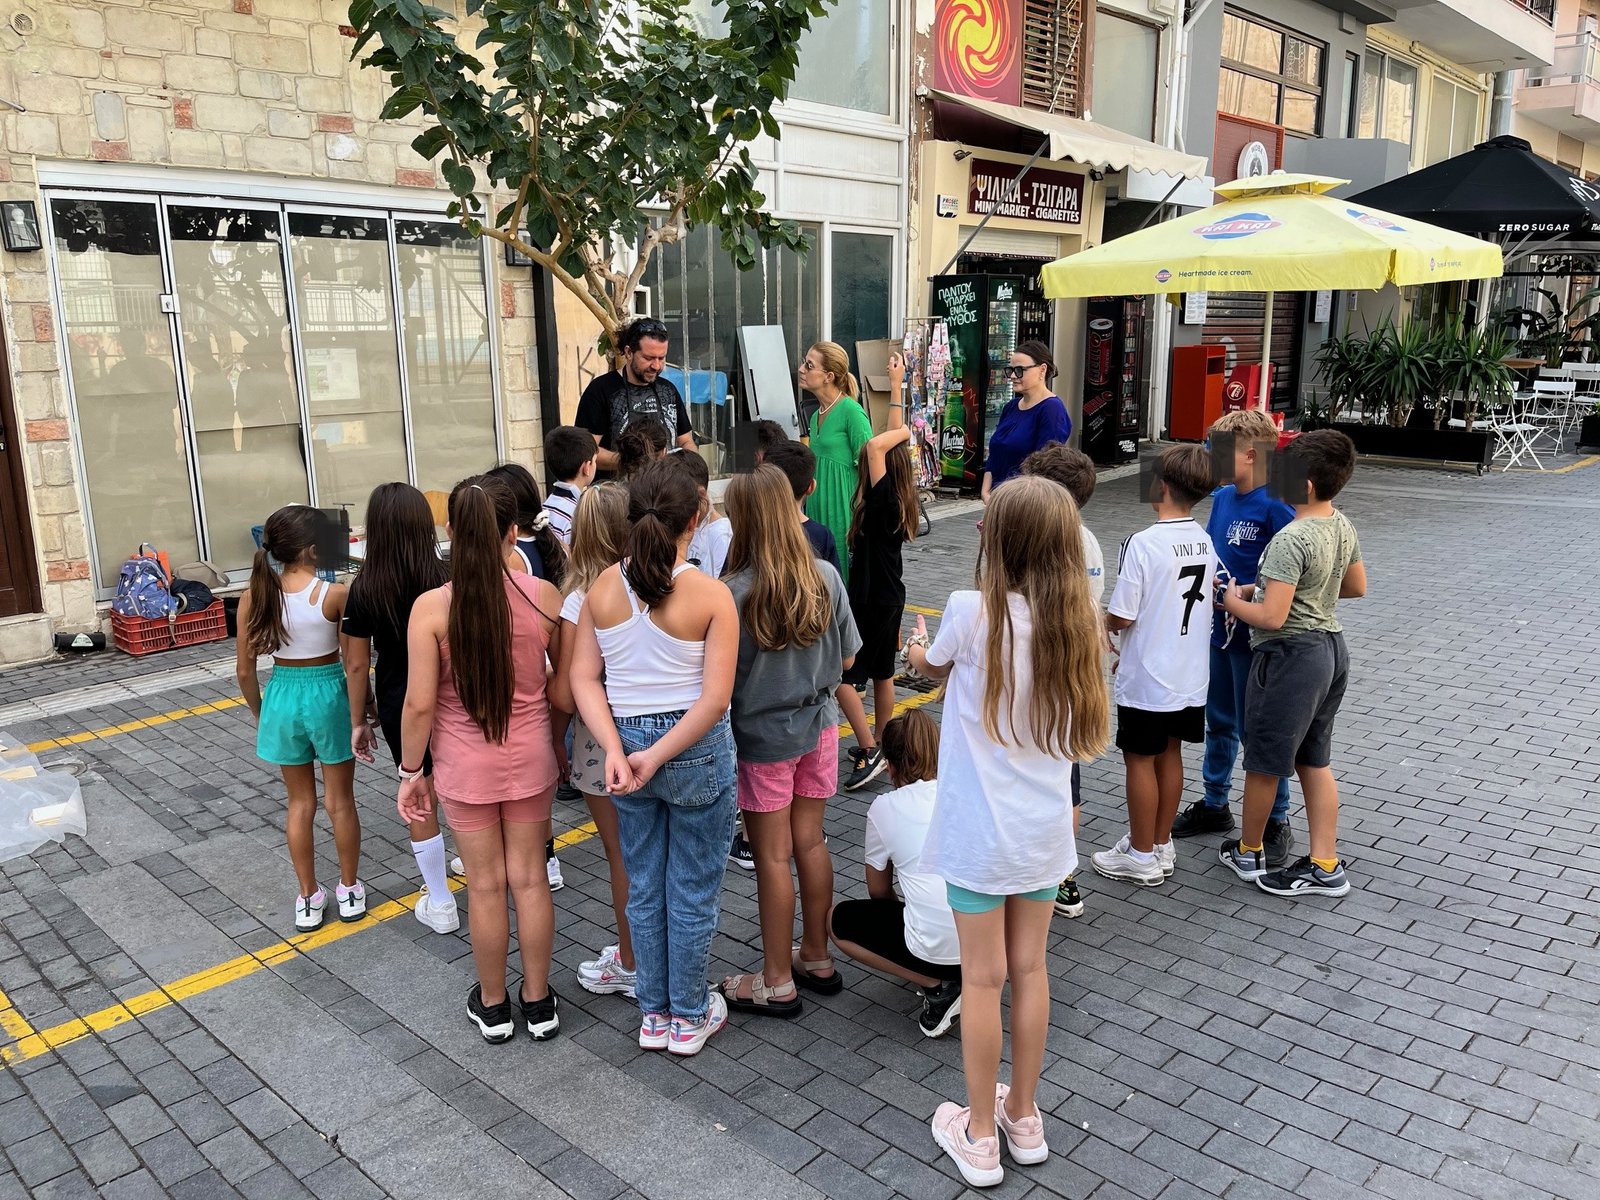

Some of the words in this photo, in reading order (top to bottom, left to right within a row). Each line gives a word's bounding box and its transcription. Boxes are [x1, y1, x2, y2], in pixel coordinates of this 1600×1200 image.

[1032, 182, 1078, 211] ΤΣΙΓΑΡΑ
[996, 203, 1030, 218] MARKET
[1036, 207, 1080, 222] CIGARETTES
[1498, 223, 1530, 231] ZERO
[1531, 223, 1571, 231] SUGAR
[1178, 270, 1217, 278] Heartmade
[1230, 269, 1253, 277] cream.
[938, 281, 972, 300] ΠΑΝΤΟΥ
[944, 292, 976, 307] ΥΠΑΡΧΕΙ
[950, 303, 968, 316] ΕΝΑΣ
[944, 310, 978, 327] ΜΥΘΟΣ
[1172, 543, 1193, 557] VINI
[1177, 564, 1207, 636] 7
[740, 850, 753, 858] NA
